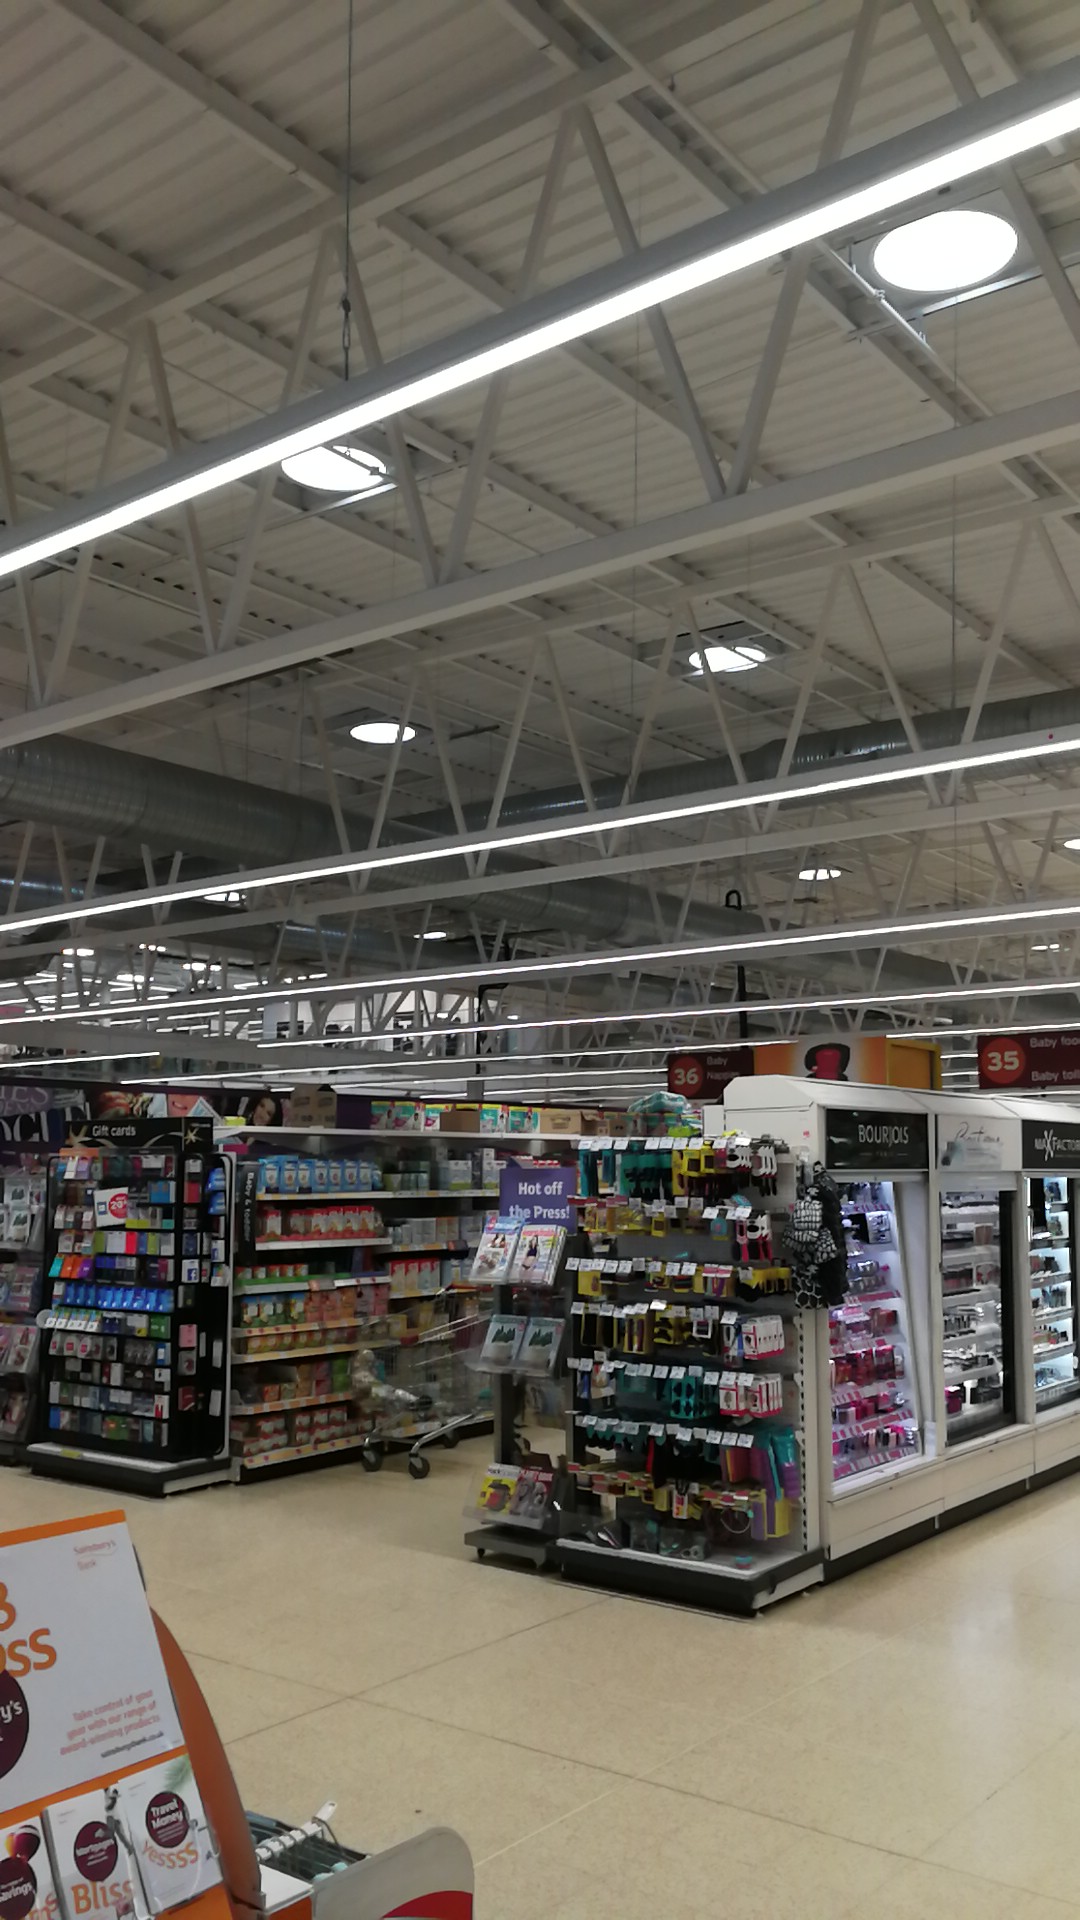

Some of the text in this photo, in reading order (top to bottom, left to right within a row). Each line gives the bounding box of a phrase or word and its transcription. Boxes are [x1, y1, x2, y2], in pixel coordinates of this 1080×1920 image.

[1029, 1037, 1057, 1048] Baby
[706, 1056, 728, 1066] Baby
[987, 1050, 1019, 1071] 35
[674, 1067, 699, 1086] 36
[1031, 1070, 1059, 1082] Baby
[92, 1124, 137, 1137] Gift cards
[858, 1123, 909, 1148] BOURJOIS
[518, 1181, 564, 1196] Hot off
[508, 1204, 570, 1219] the Press!
[151, 1798, 179, 1818] Travel
[151, 1810, 184, 1830] Money
